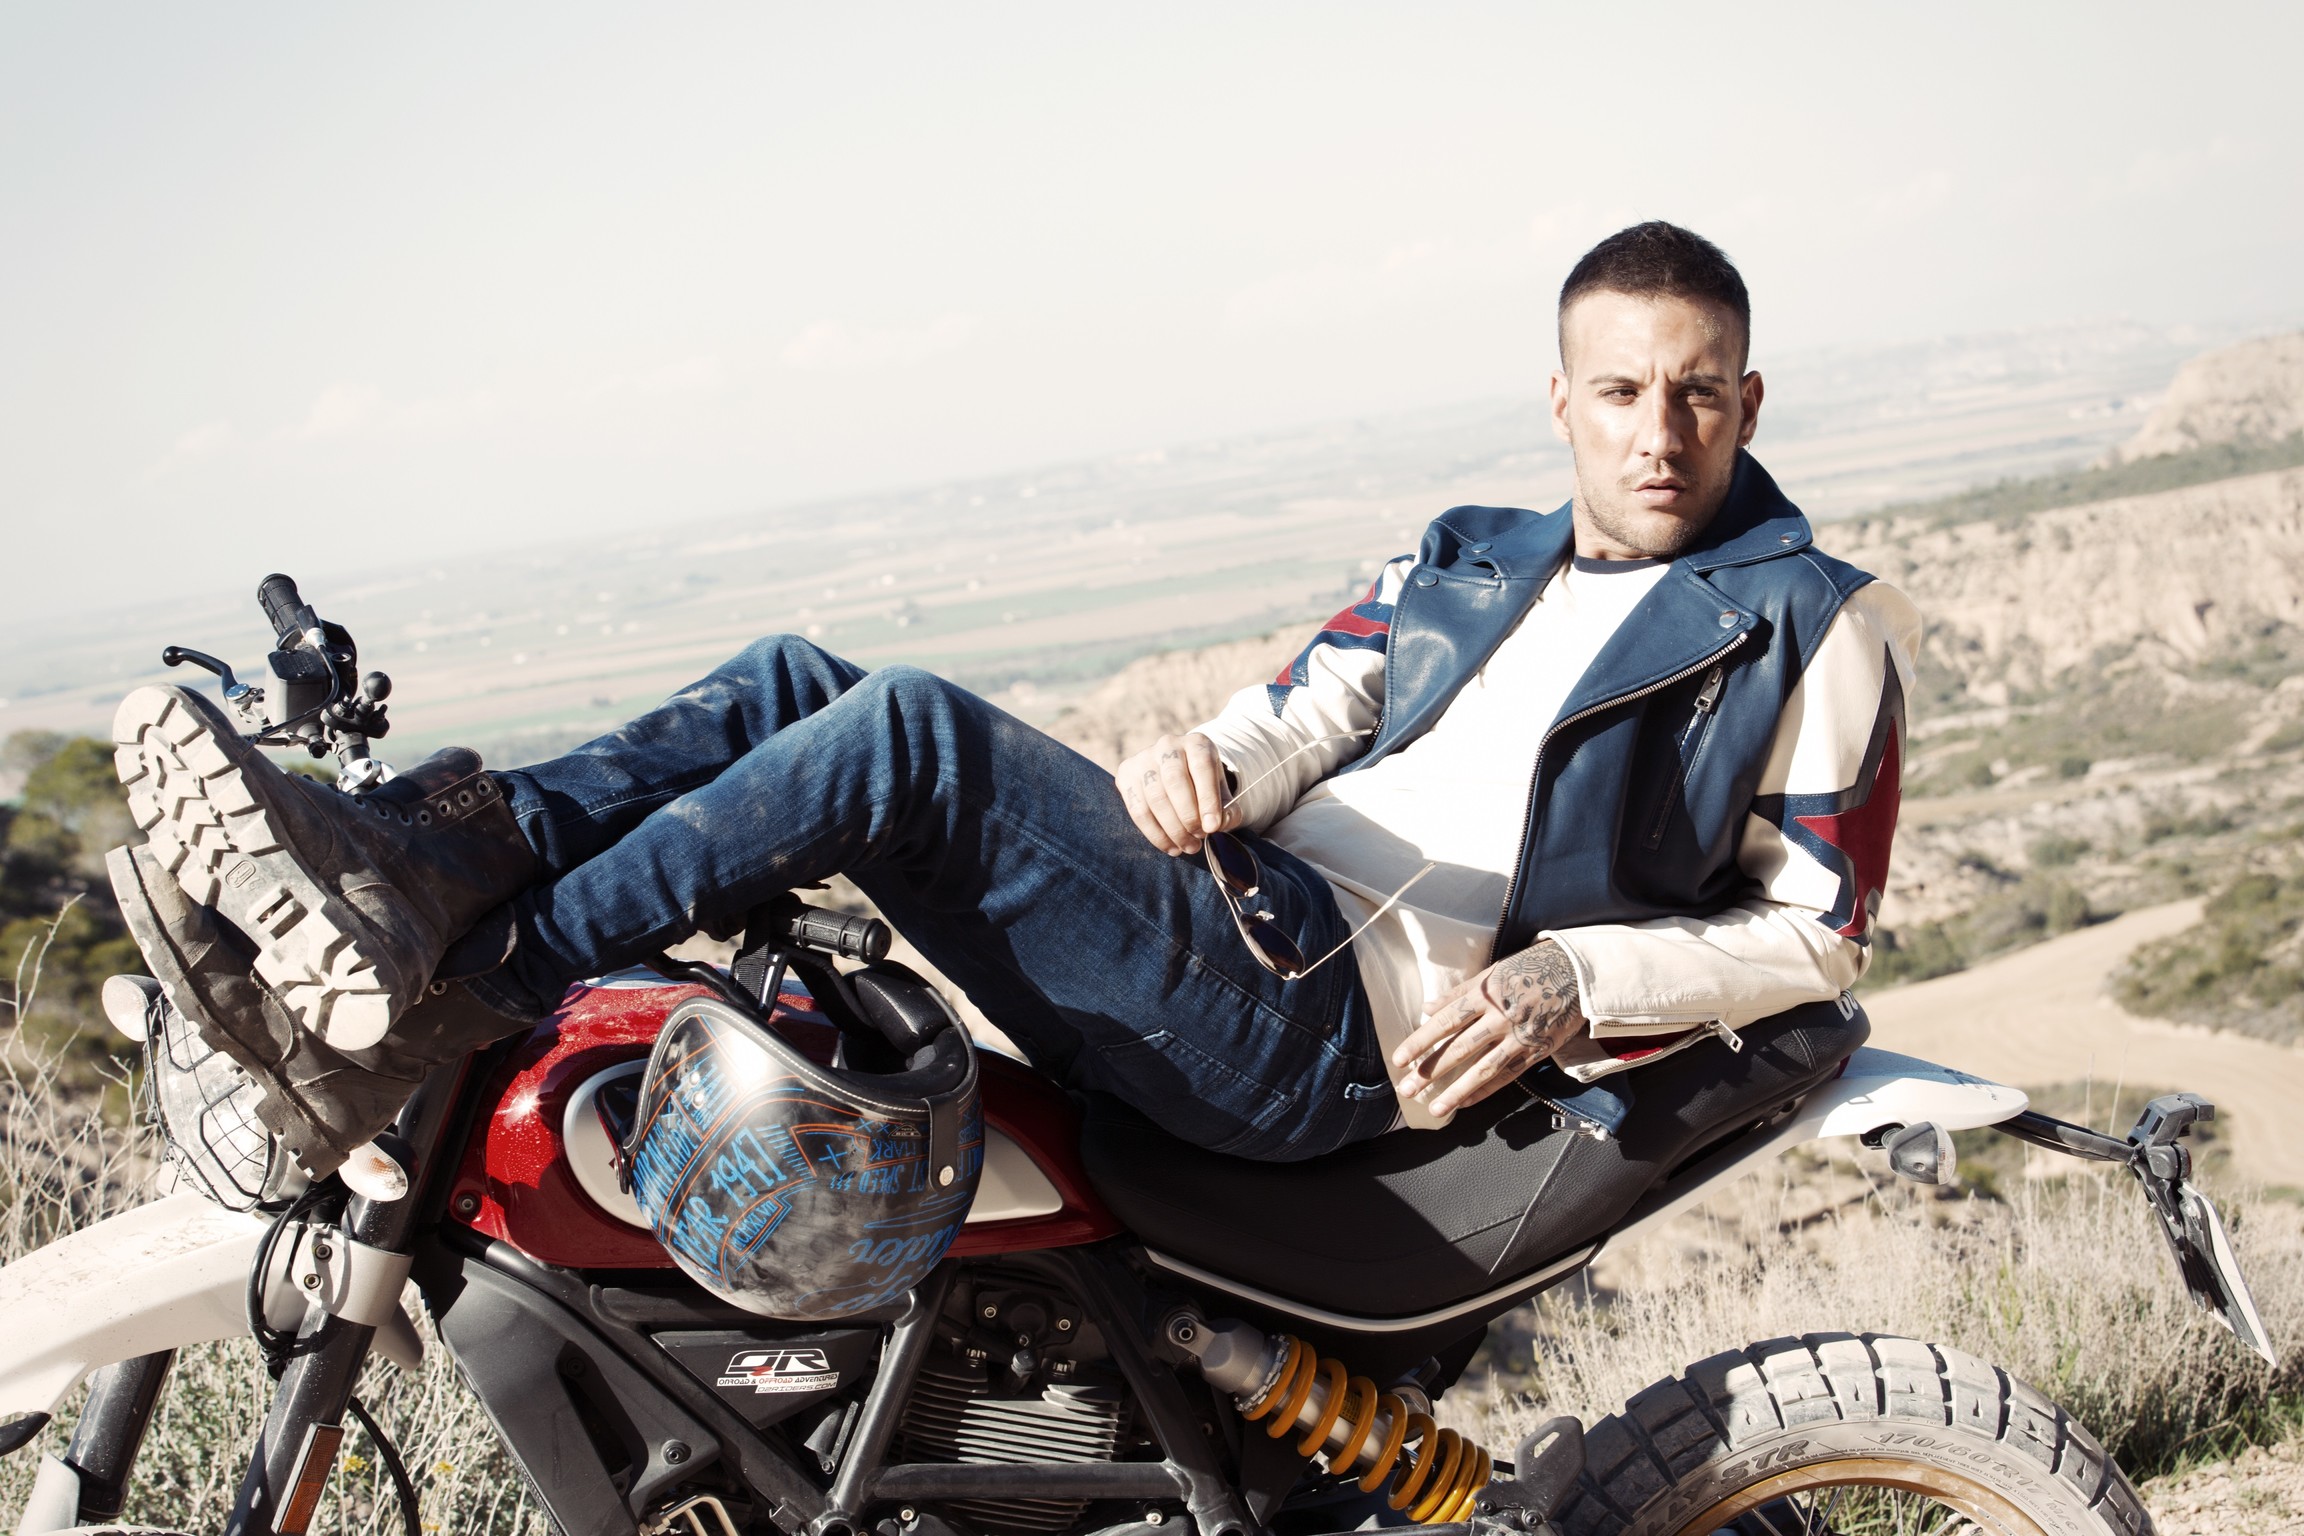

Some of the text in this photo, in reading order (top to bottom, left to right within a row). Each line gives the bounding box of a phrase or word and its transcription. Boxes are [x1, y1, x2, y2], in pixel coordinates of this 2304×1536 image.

[858, 1165, 905, 1194] SPEED
[673, 1126, 788, 1276] YEAR 1947
[758, 1377, 793, 1385] OFFROAD
[794, 1373, 838, 1384] ADVENTURES
[1720, 1439, 1810, 1485] STR
